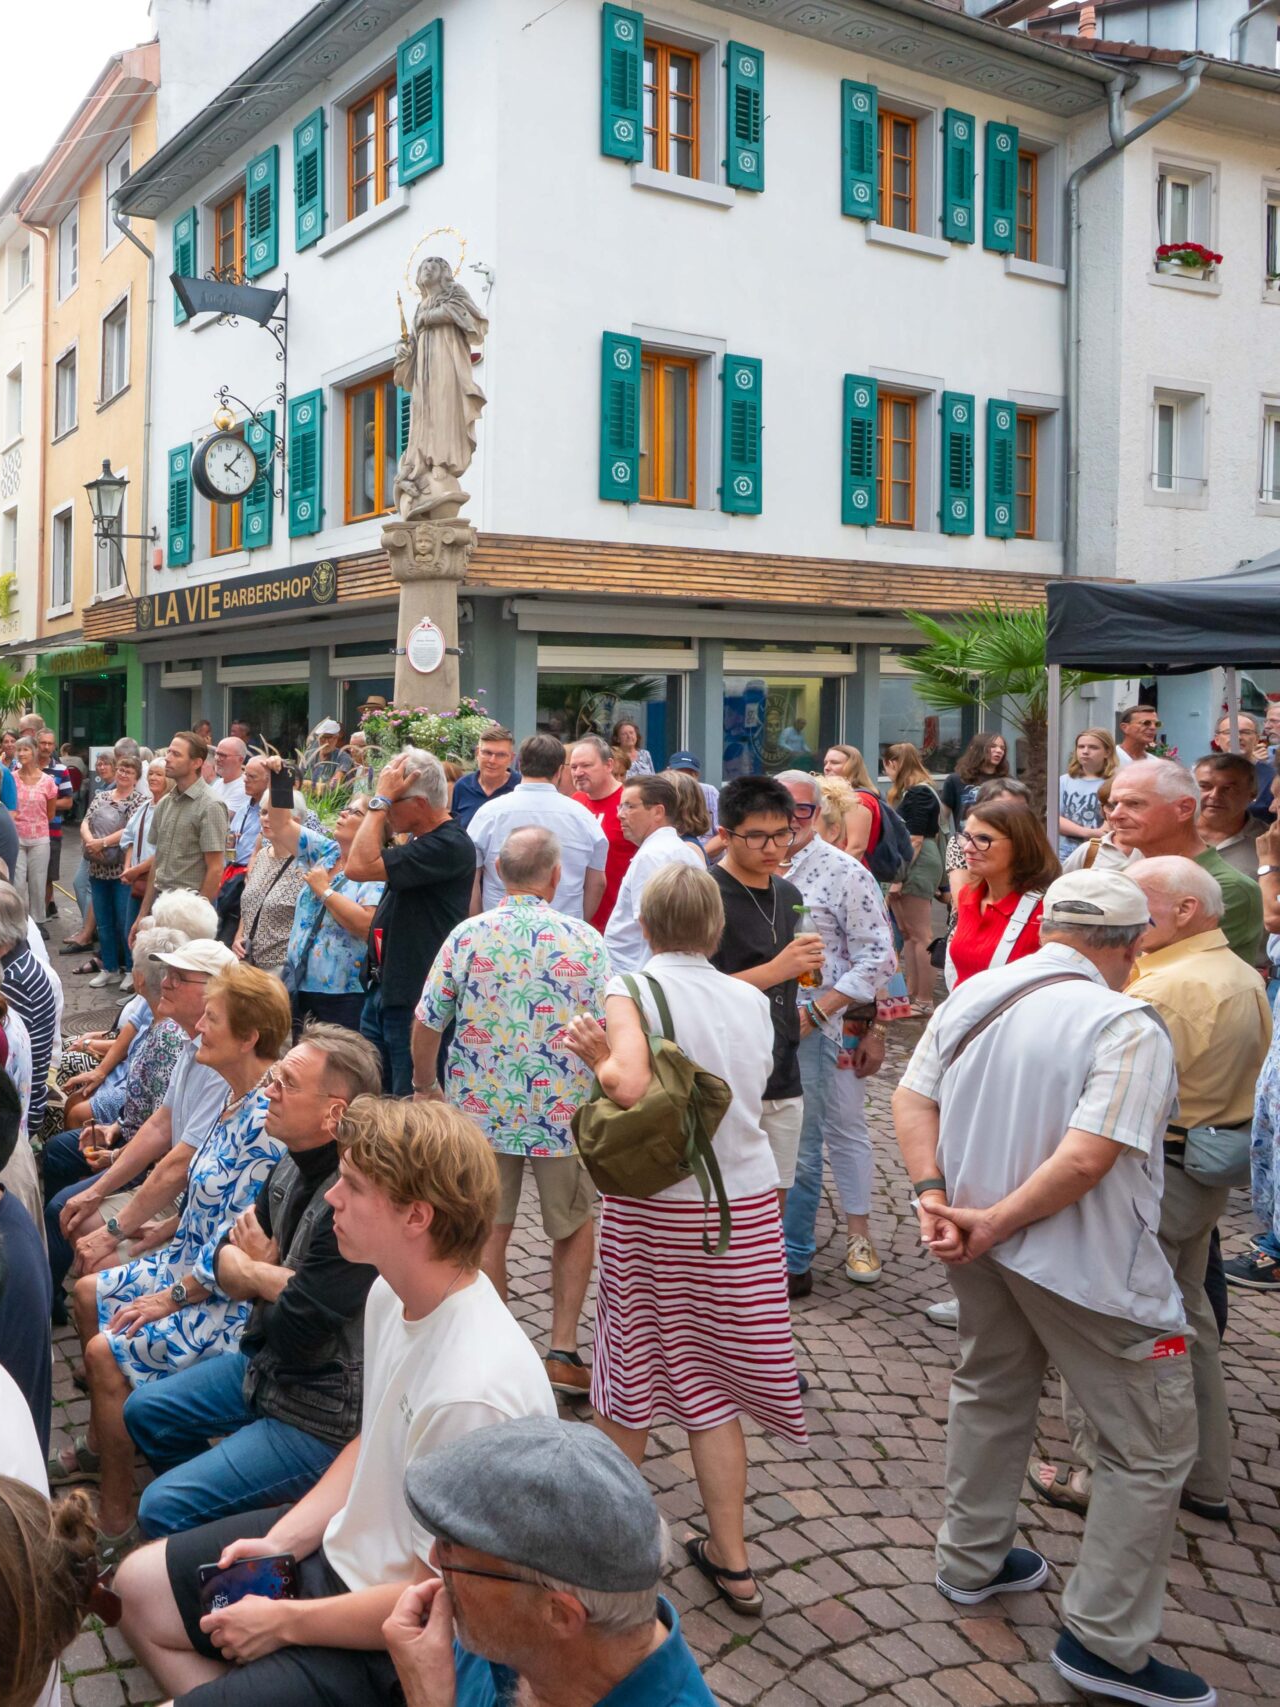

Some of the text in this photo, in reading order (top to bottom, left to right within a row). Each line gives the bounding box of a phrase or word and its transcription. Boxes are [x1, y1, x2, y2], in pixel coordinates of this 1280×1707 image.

[154, 594, 180, 627] LA
[186, 583, 221, 623] VIE
[223, 576, 311, 609] BARBERSHOP
